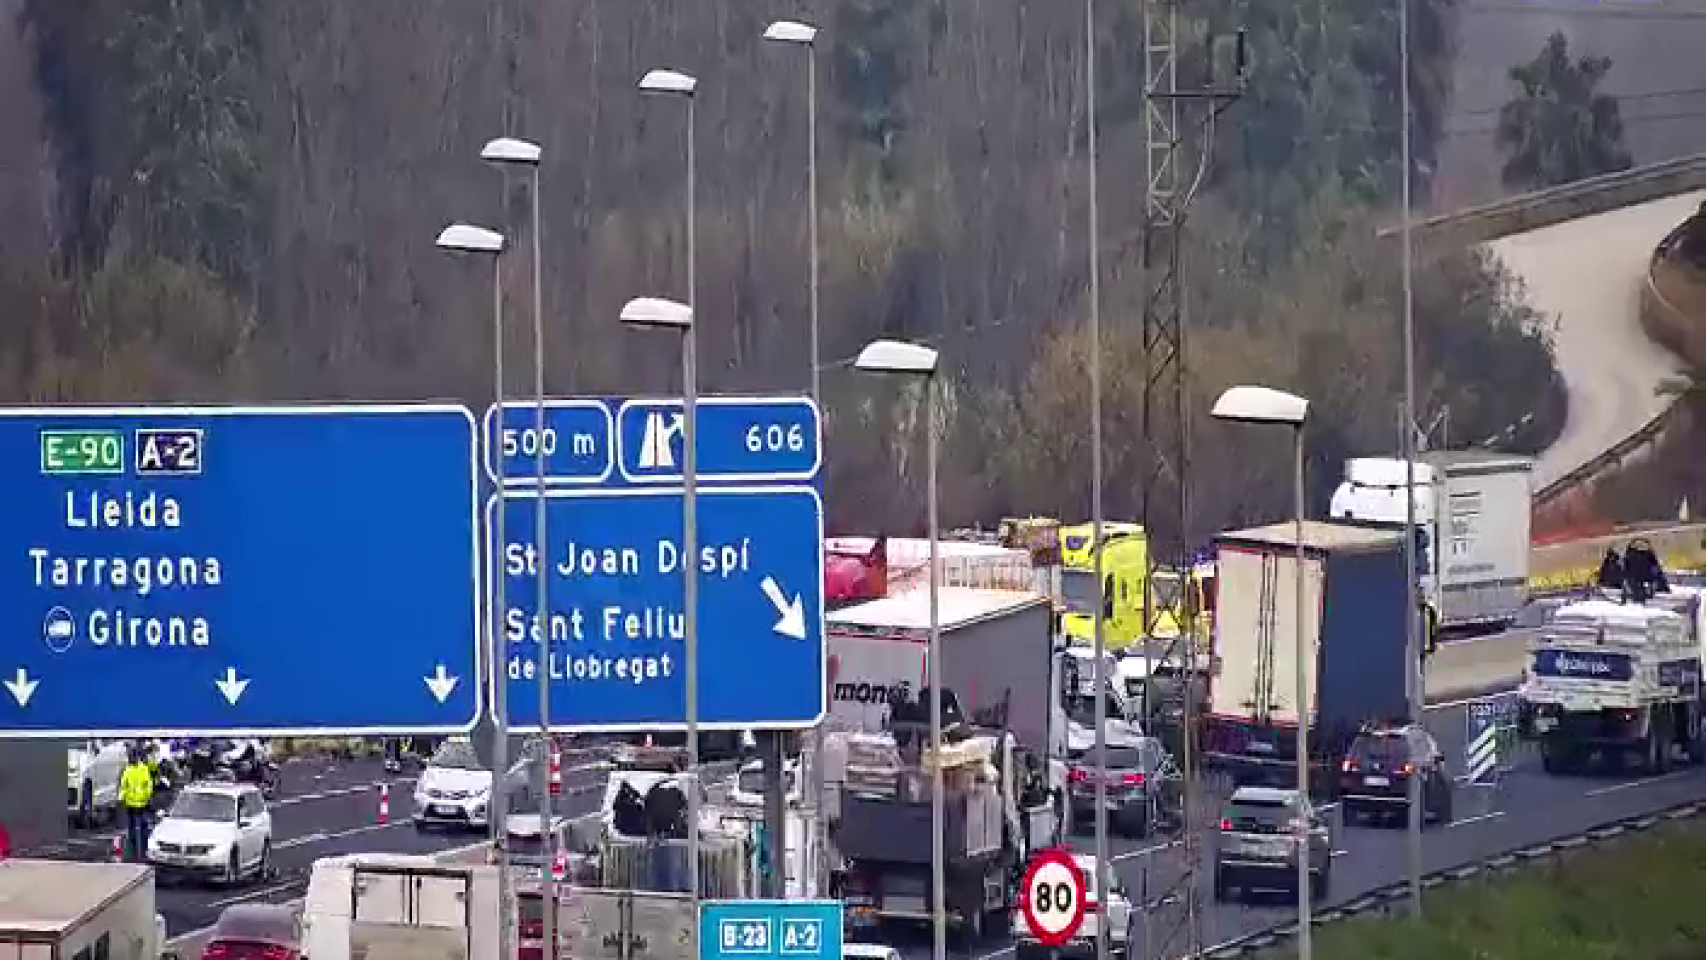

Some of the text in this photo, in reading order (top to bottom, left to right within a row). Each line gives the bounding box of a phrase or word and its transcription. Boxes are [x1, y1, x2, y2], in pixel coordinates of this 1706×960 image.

[47, 435, 196, 467] E-90 A-2
[503, 428, 596, 456] 500 m
[745, 423, 803, 451] 606
[66, 490, 180, 527] Lleida
[28, 548, 222, 595] Tarragona
[505, 542, 539, 575] St
[557, 541, 638, 575] Joan
[88, 607, 209, 646] Girona
[603, 605, 686, 640] Feliu
[508, 651, 672, 684] de Llobregat
[1036, 882, 1072, 914] 80
[784, 923, 816, 946] A-2
